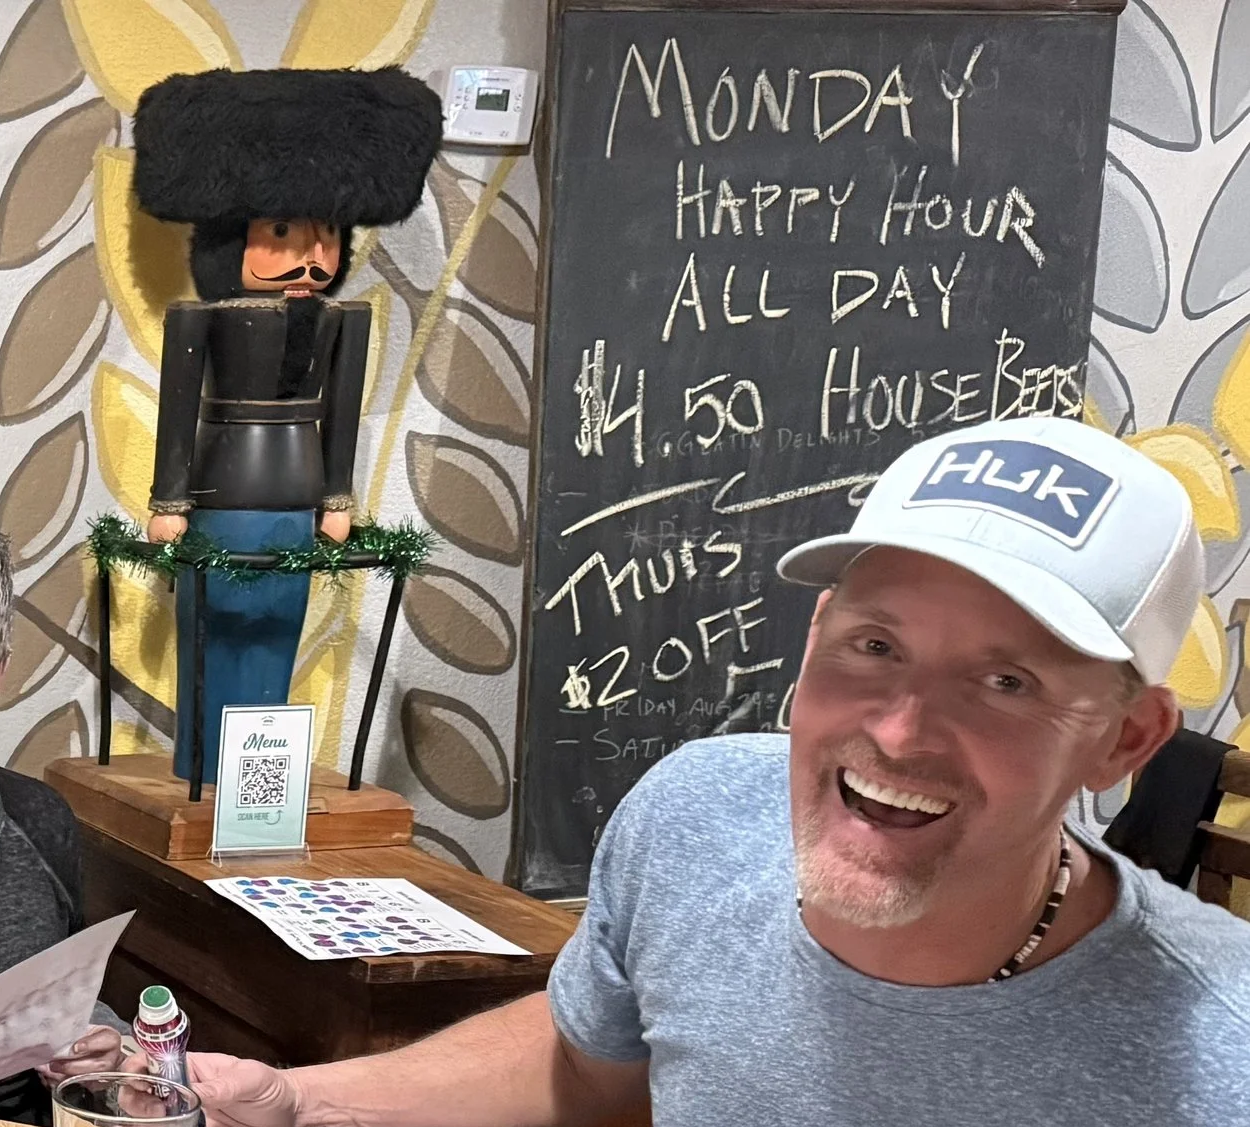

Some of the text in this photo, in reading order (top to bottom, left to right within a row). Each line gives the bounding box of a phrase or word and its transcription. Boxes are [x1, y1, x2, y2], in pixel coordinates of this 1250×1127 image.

[605, 38, 985, 167] MONDAY
[675, 160, 1044, 268] HAPPY HOUR
[662, 252, 965, 341] ALL DAY
[822, 347, 982, 438] HOUSE
[653, 597, 767, 682] OFF
[243, 733, 289, 752] Menu
